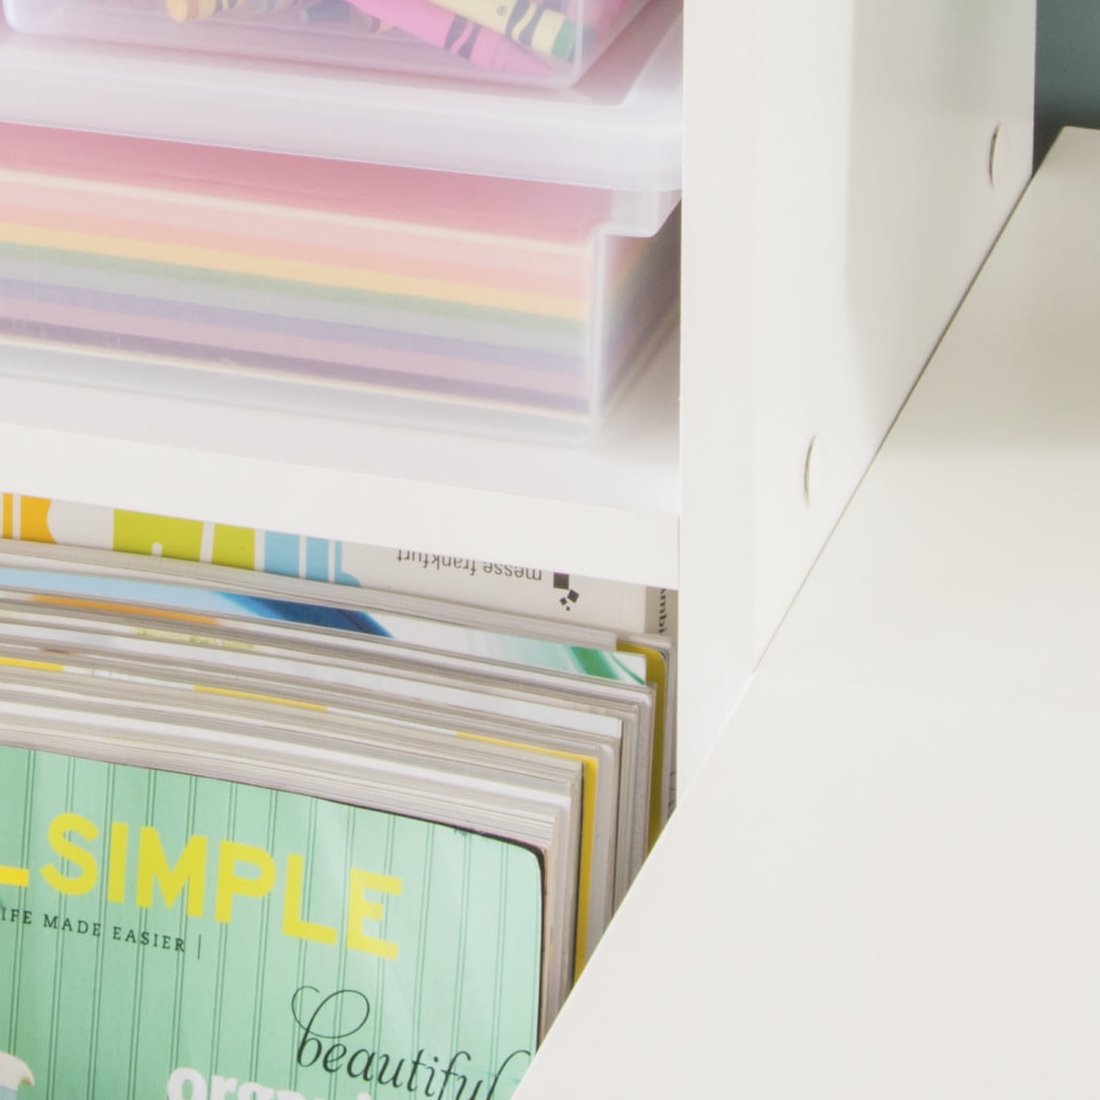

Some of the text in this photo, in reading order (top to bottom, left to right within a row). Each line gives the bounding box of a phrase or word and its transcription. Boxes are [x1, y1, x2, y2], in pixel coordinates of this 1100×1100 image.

[396, 549, 543, 582] messe frankfurt
[40, 813, 403, 961] SIMPLE
[43, 913, 102, 937] MADE
[112, 926, 186, 953] EASIER
